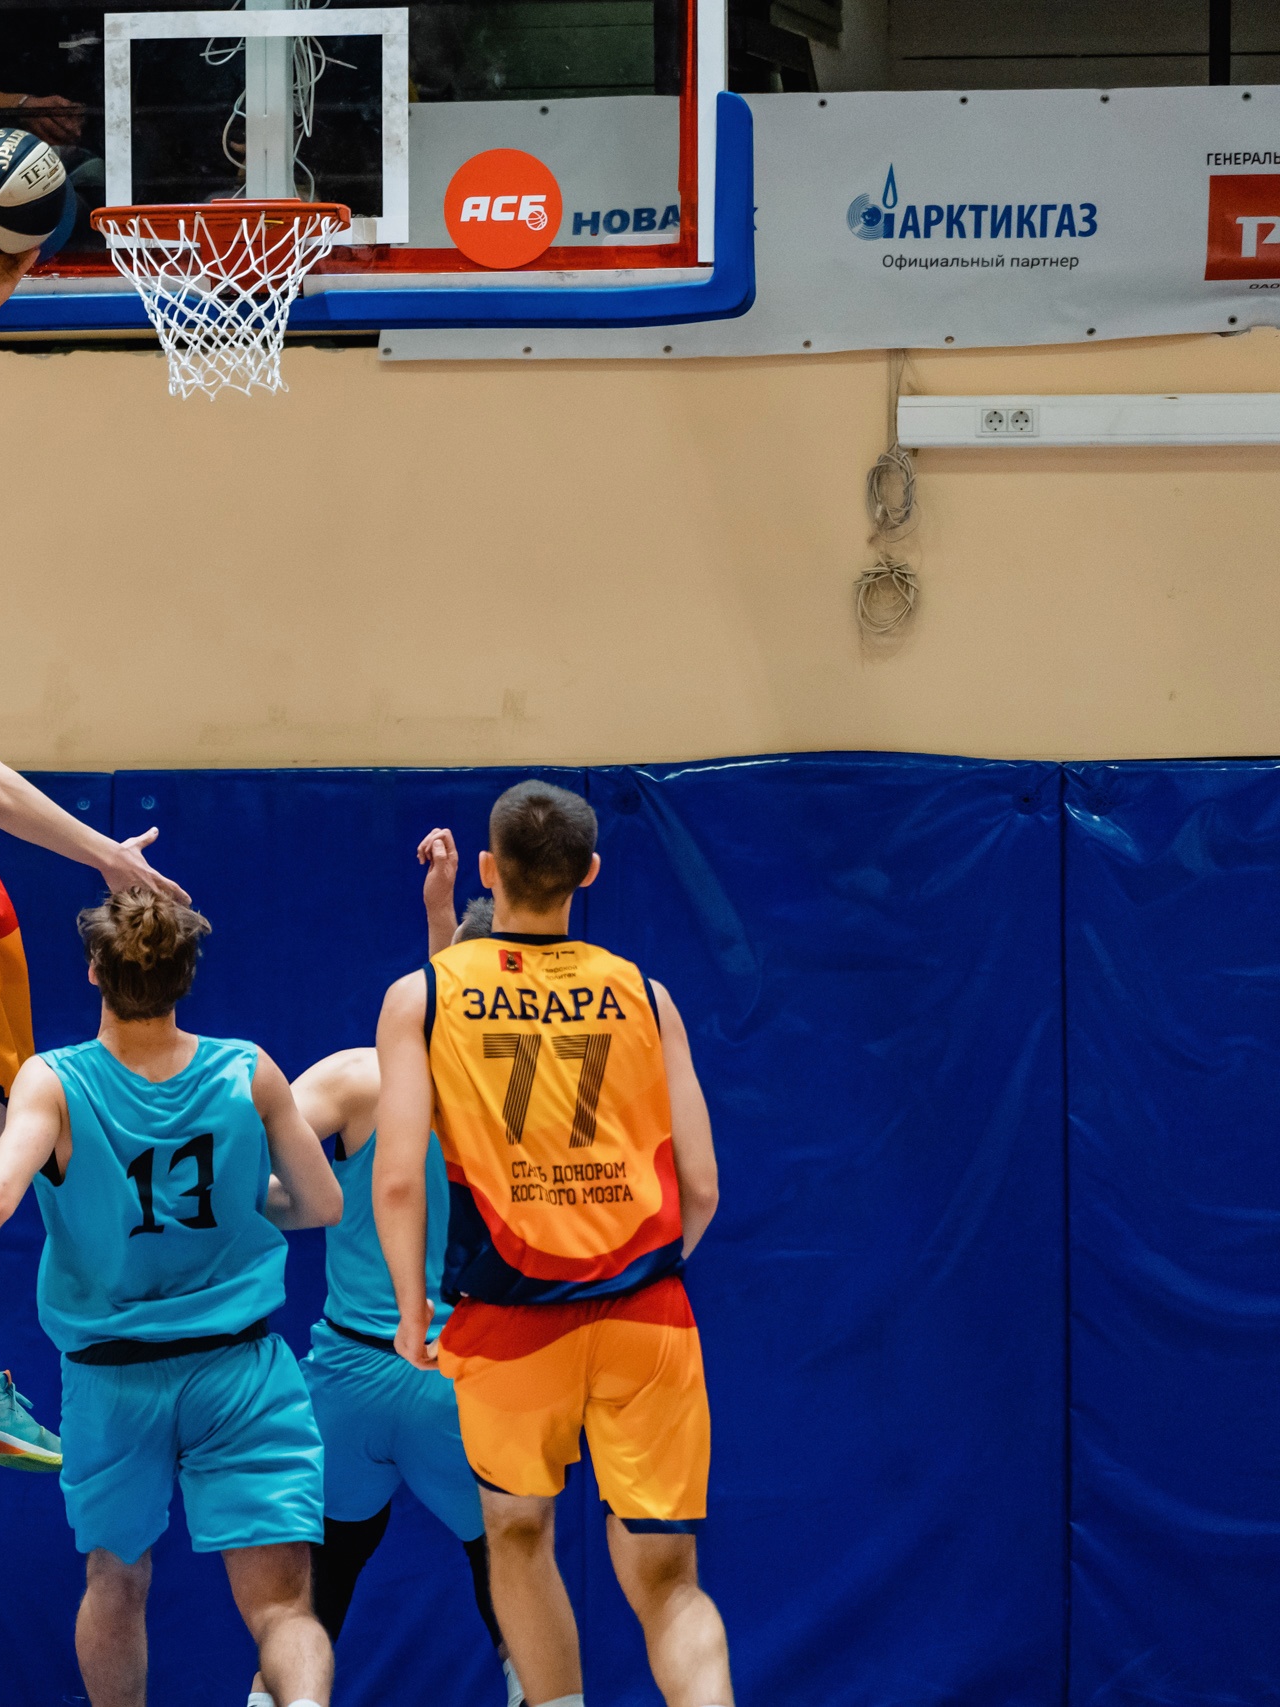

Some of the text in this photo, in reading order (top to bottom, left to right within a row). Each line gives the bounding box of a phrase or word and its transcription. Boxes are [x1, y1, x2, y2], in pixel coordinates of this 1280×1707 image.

[460, 195, 549, 231] АСБ
[898, 203, 1098, 239] АРКТИКГАЗ
[882, 254, 1080, 270] Официальный партнер
[462, 986, 626, 1024] ЗАБАРА
[483, 1033, 612, 1148] 77
[127, 1133, 218, 1239] 13
[552, 1162, 626, 1184] ДОНОРОМ
[583, 1184, 634, 1204] МОЗГА
